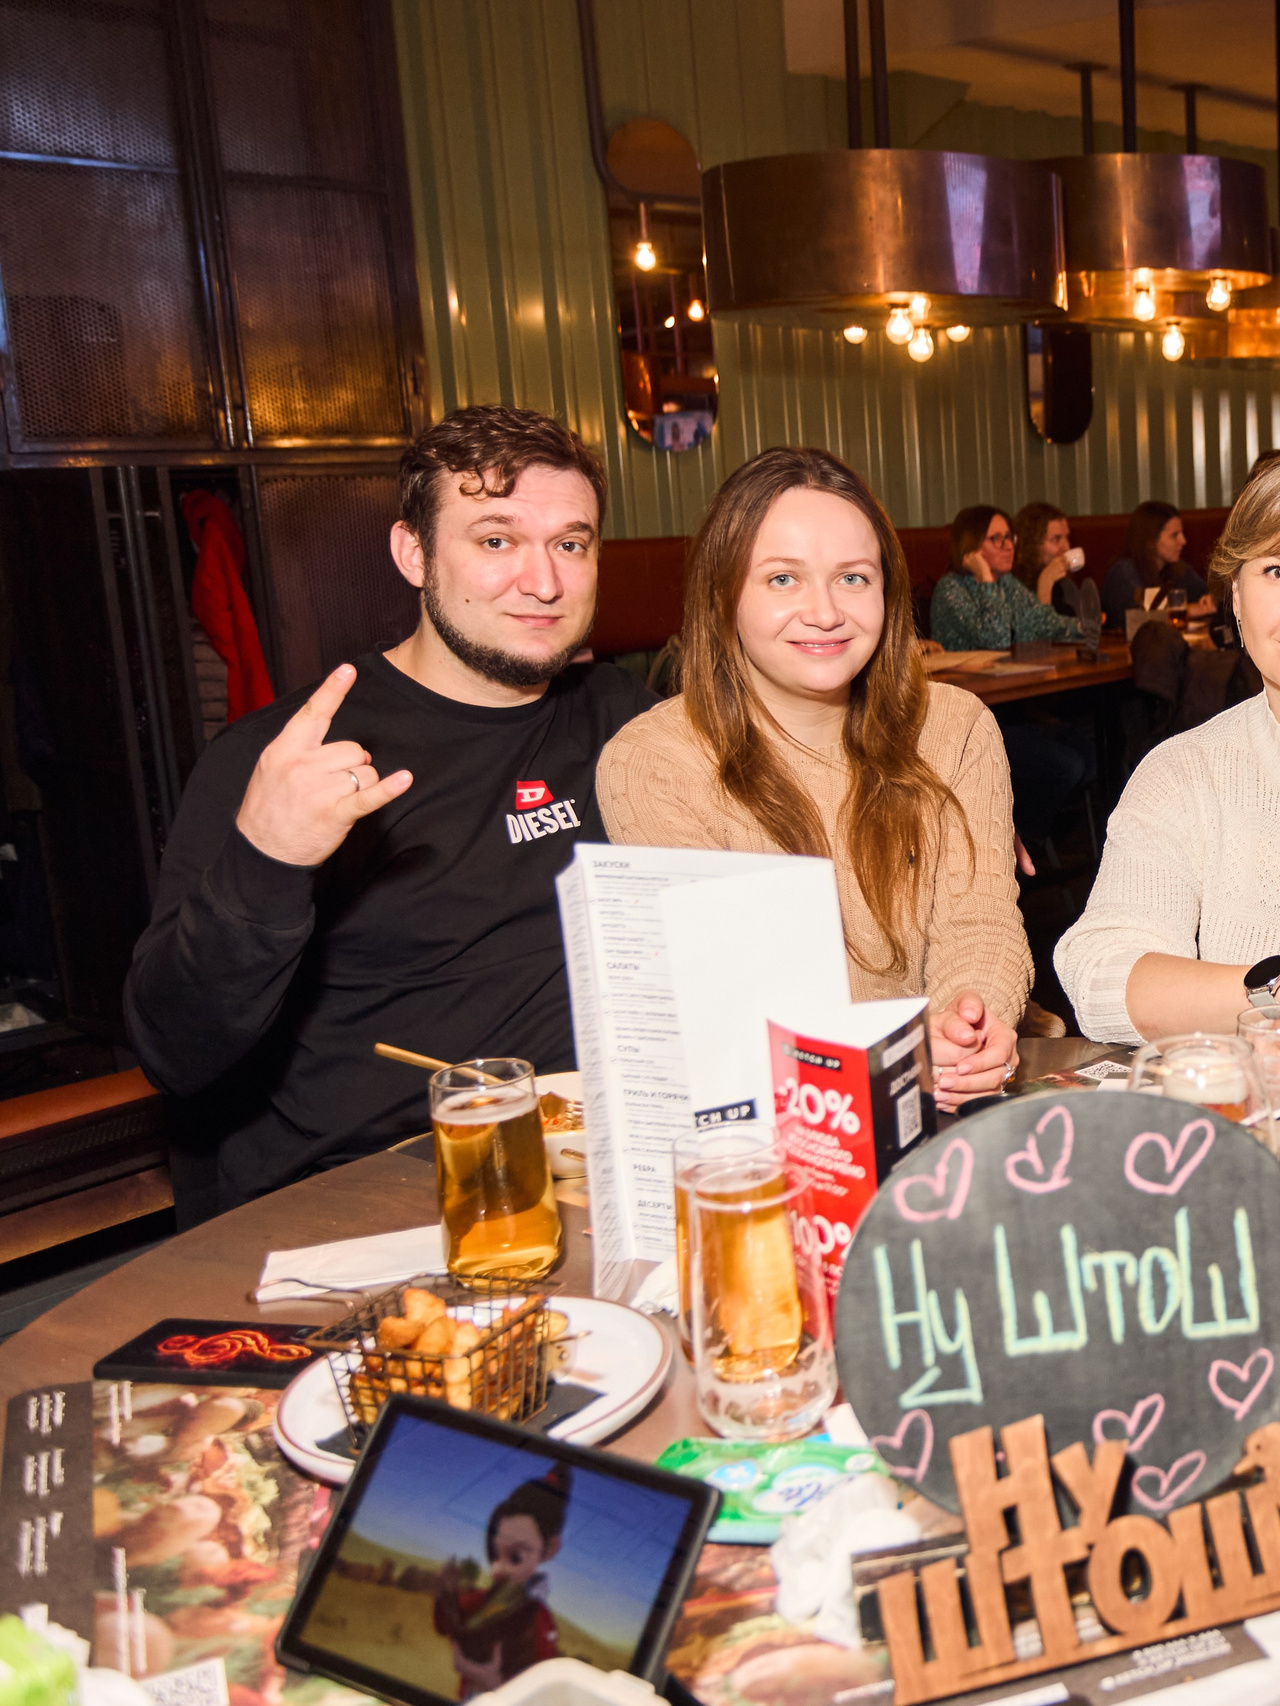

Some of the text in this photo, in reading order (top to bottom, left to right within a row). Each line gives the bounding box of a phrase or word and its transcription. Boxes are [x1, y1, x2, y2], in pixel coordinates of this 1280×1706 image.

[506, 800, 581, 844] DIESEL
[606, 962, 640, 971] САЛАТЫ
[725, 1104, 751, 1120] UP
[778, 1077, 862, 1136] -20%
[873, 1239, 983, 1409] Ну
